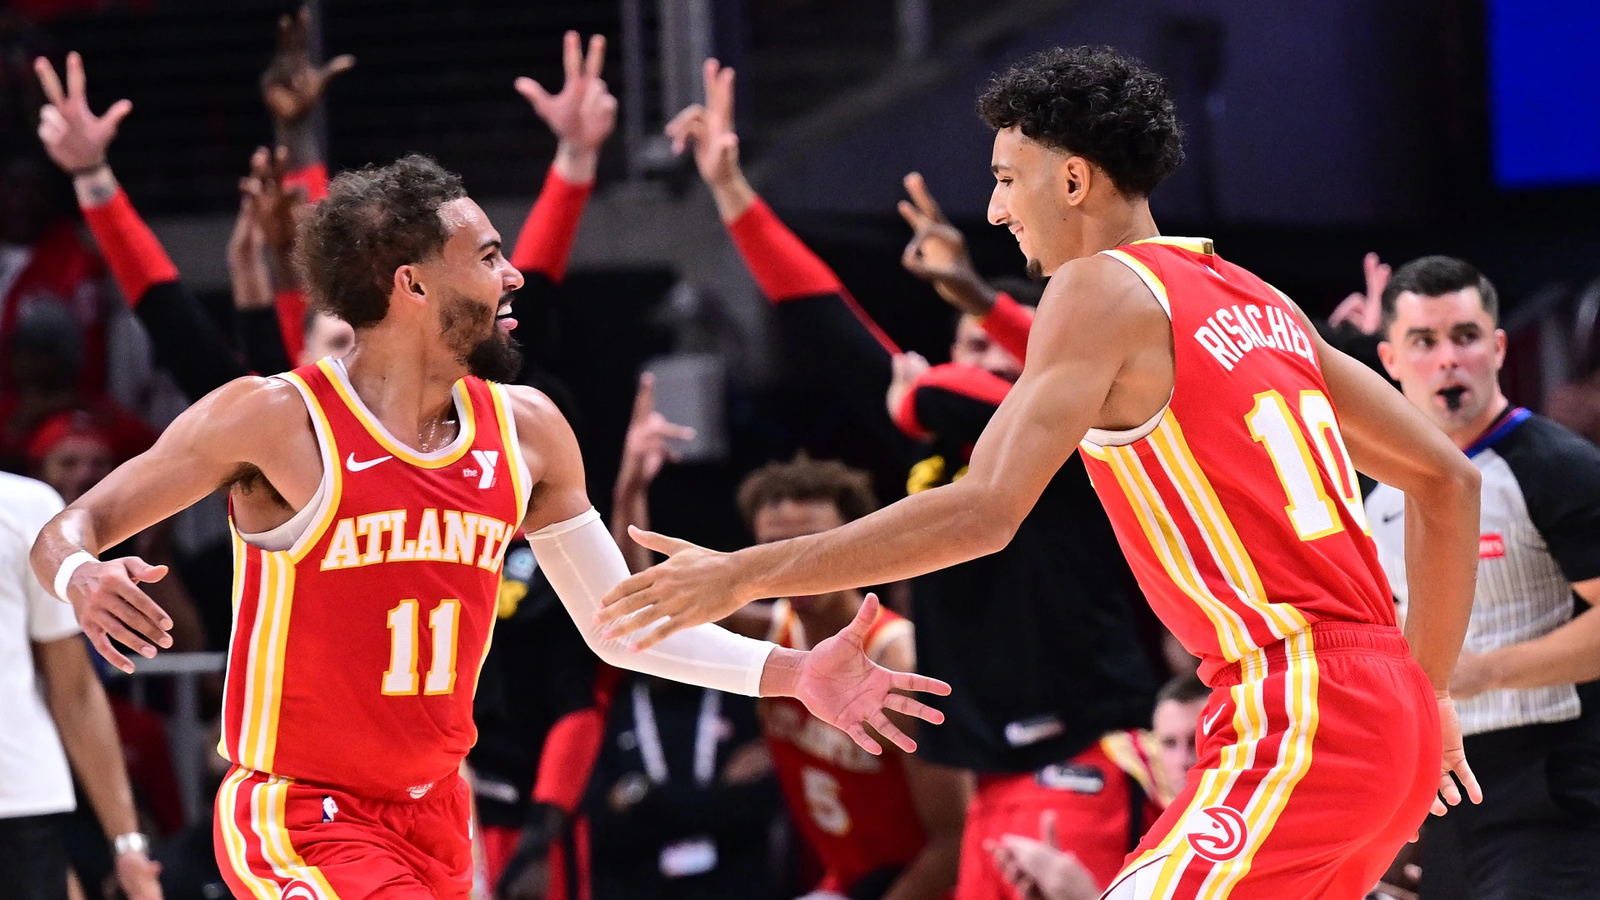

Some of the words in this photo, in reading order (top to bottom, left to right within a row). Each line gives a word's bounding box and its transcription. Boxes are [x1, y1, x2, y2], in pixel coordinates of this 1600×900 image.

[462, 468, 478, 477] the
[1244, 389, 1372, 541] 10
[381, 599, 461, 696] 11
